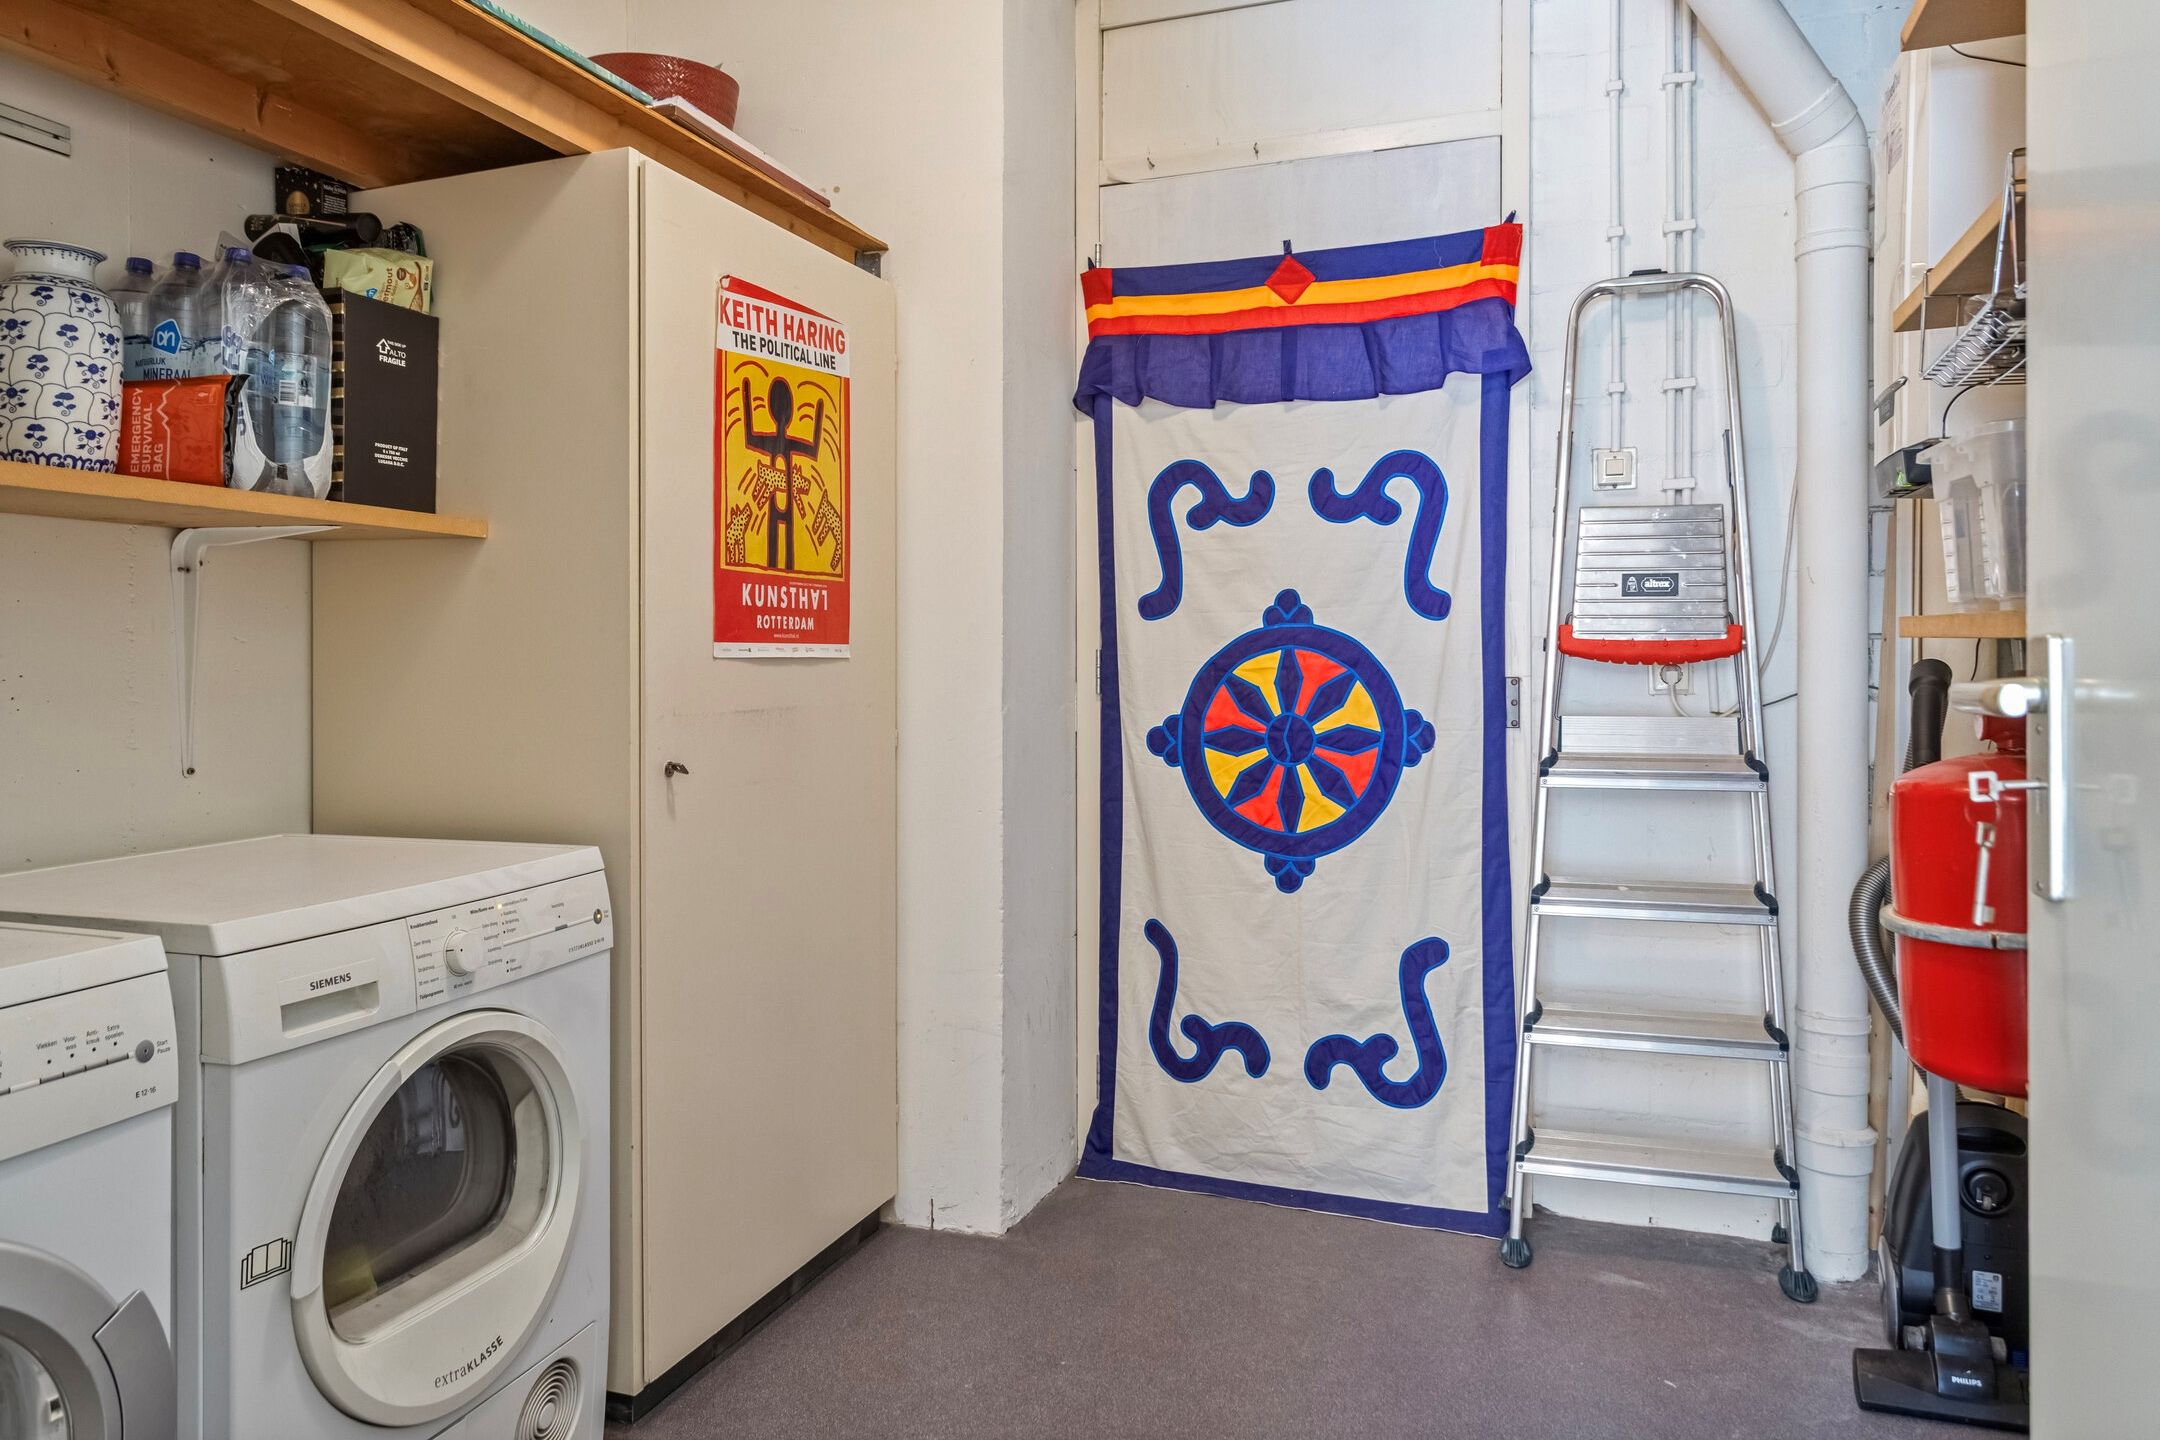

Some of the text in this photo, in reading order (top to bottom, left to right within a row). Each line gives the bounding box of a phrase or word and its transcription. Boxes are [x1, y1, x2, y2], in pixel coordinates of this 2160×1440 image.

[719, 295, 846, 354] KEITH HARING
[379, 355, 406, 367] FRAGILE
[732, 331, 836, 370] THE POLITICAL LINE
[130, 388, 143, 473] EMERGENCY
[142, 403, 153, 473] SURVIVAL
[153, 444, 163, 472] BAG
[1644, 579, 1671, 588] altrex
[756, 614, 814, 631] ROTTERDAM
[310, 972, 352, 991] SIEMENS
[36, 1040, 58, 1050] Vlekken
[434, 1335, 504, 1389] extraKLASSE
[1951, 1375, 1983, 1387] PHILIPS
